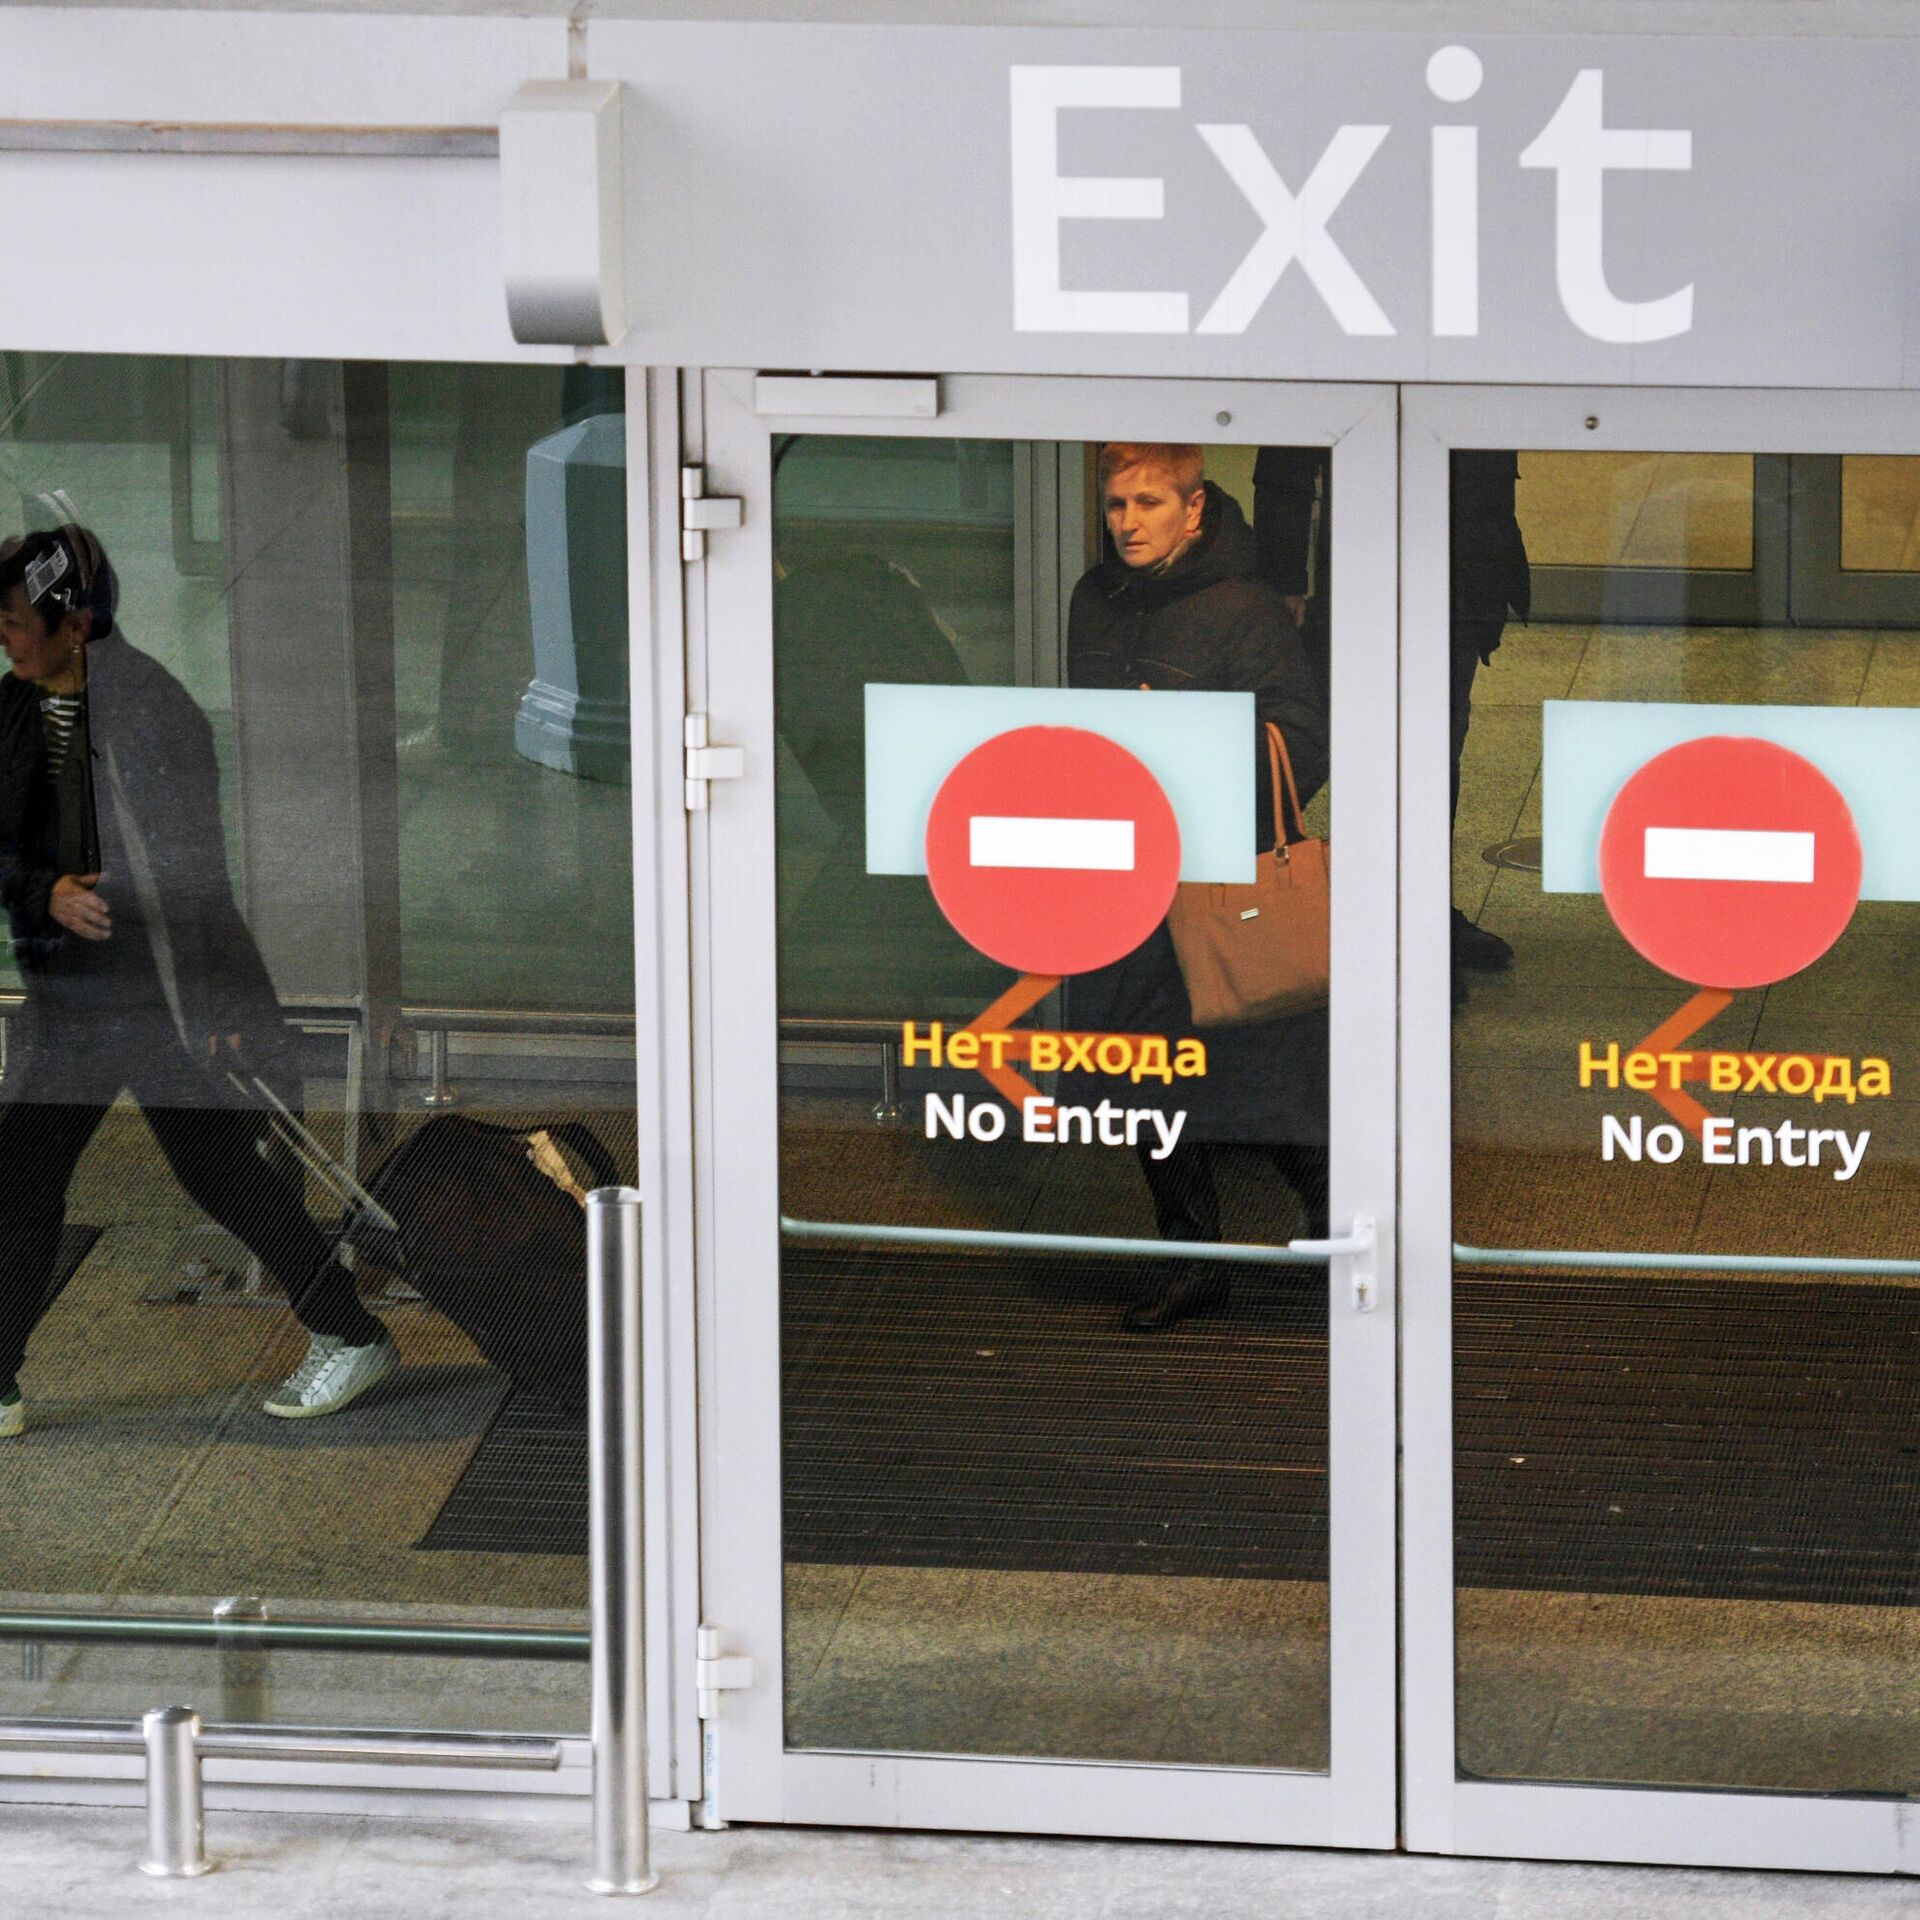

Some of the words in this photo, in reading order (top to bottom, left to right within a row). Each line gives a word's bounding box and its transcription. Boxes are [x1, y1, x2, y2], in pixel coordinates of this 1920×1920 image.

[1010, 44, 1694, 343] Exit
[902, 1021, 1014, 1070] Нет
[1030, 1032, 1207, 1084] входа
[1578, 1042, 1693, 1090] Нет
[1709, 1053, 1892, 1104] входа
[925, 1092, 1006, 1142] No
[1023, 1096, 1187, 1160] Entry
[1601, 1115, 1684, 1164] No
[1702, 1117, 1871, 1181] Entry
